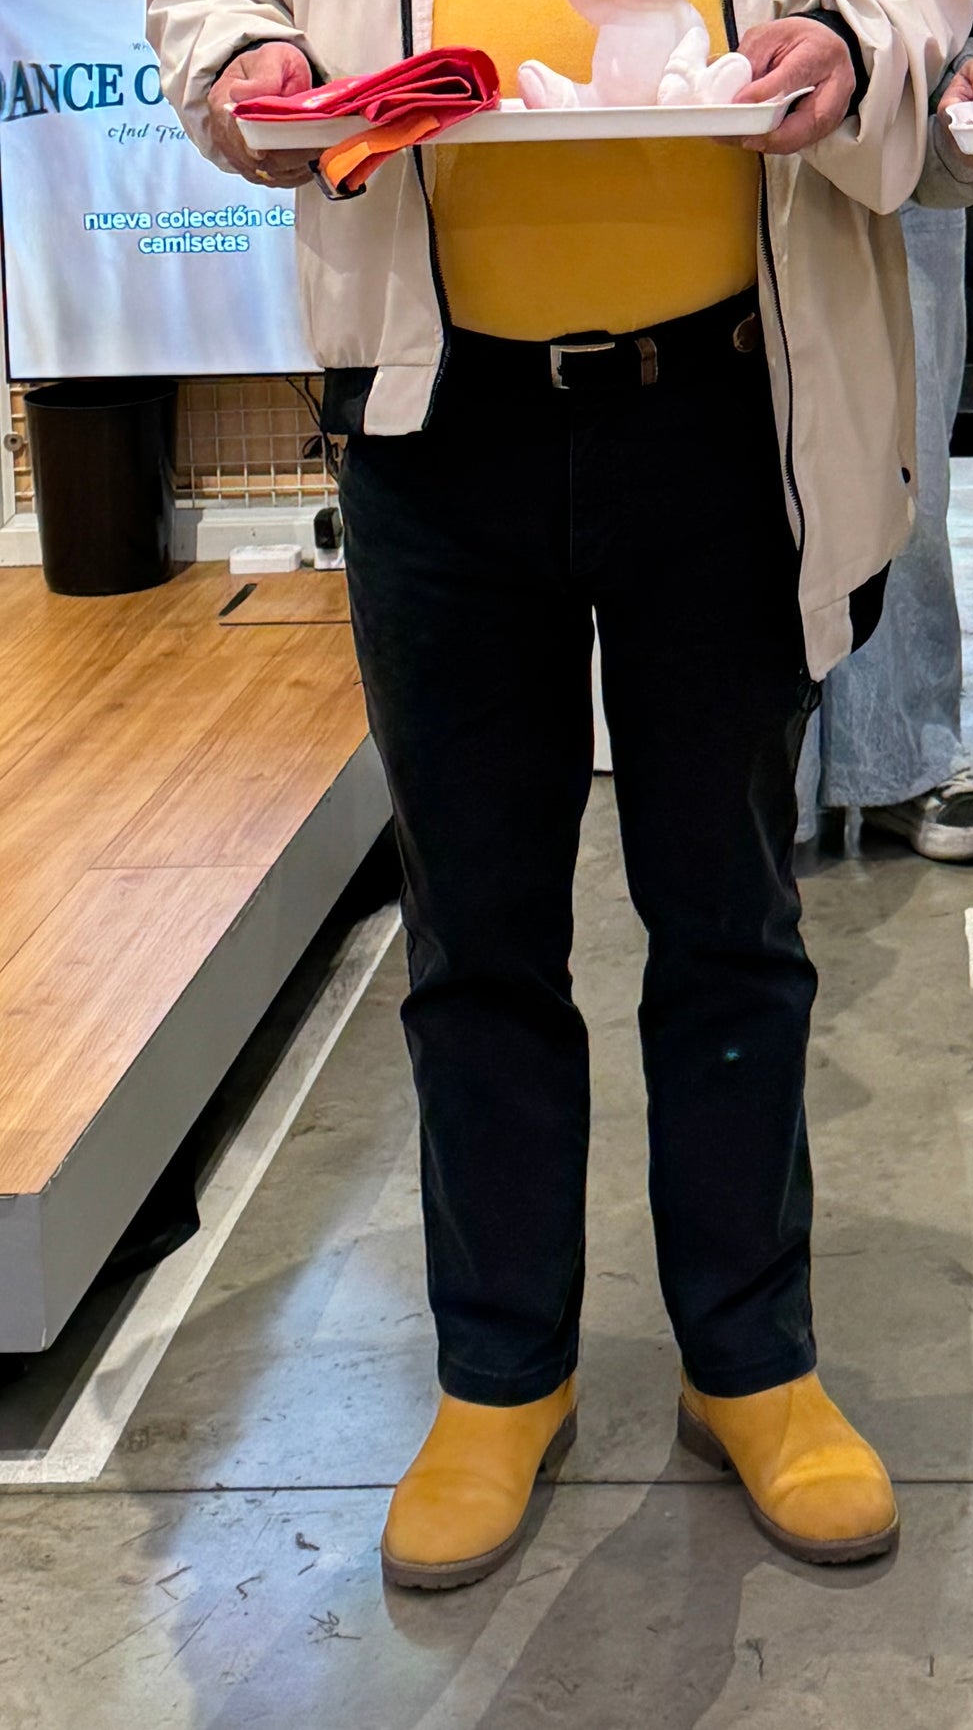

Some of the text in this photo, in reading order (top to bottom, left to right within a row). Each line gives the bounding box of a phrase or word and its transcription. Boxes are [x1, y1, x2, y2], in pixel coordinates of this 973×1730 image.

[84, 204, 296, 230] nueva colección de
[138, 231, 250, 254] camisetas
